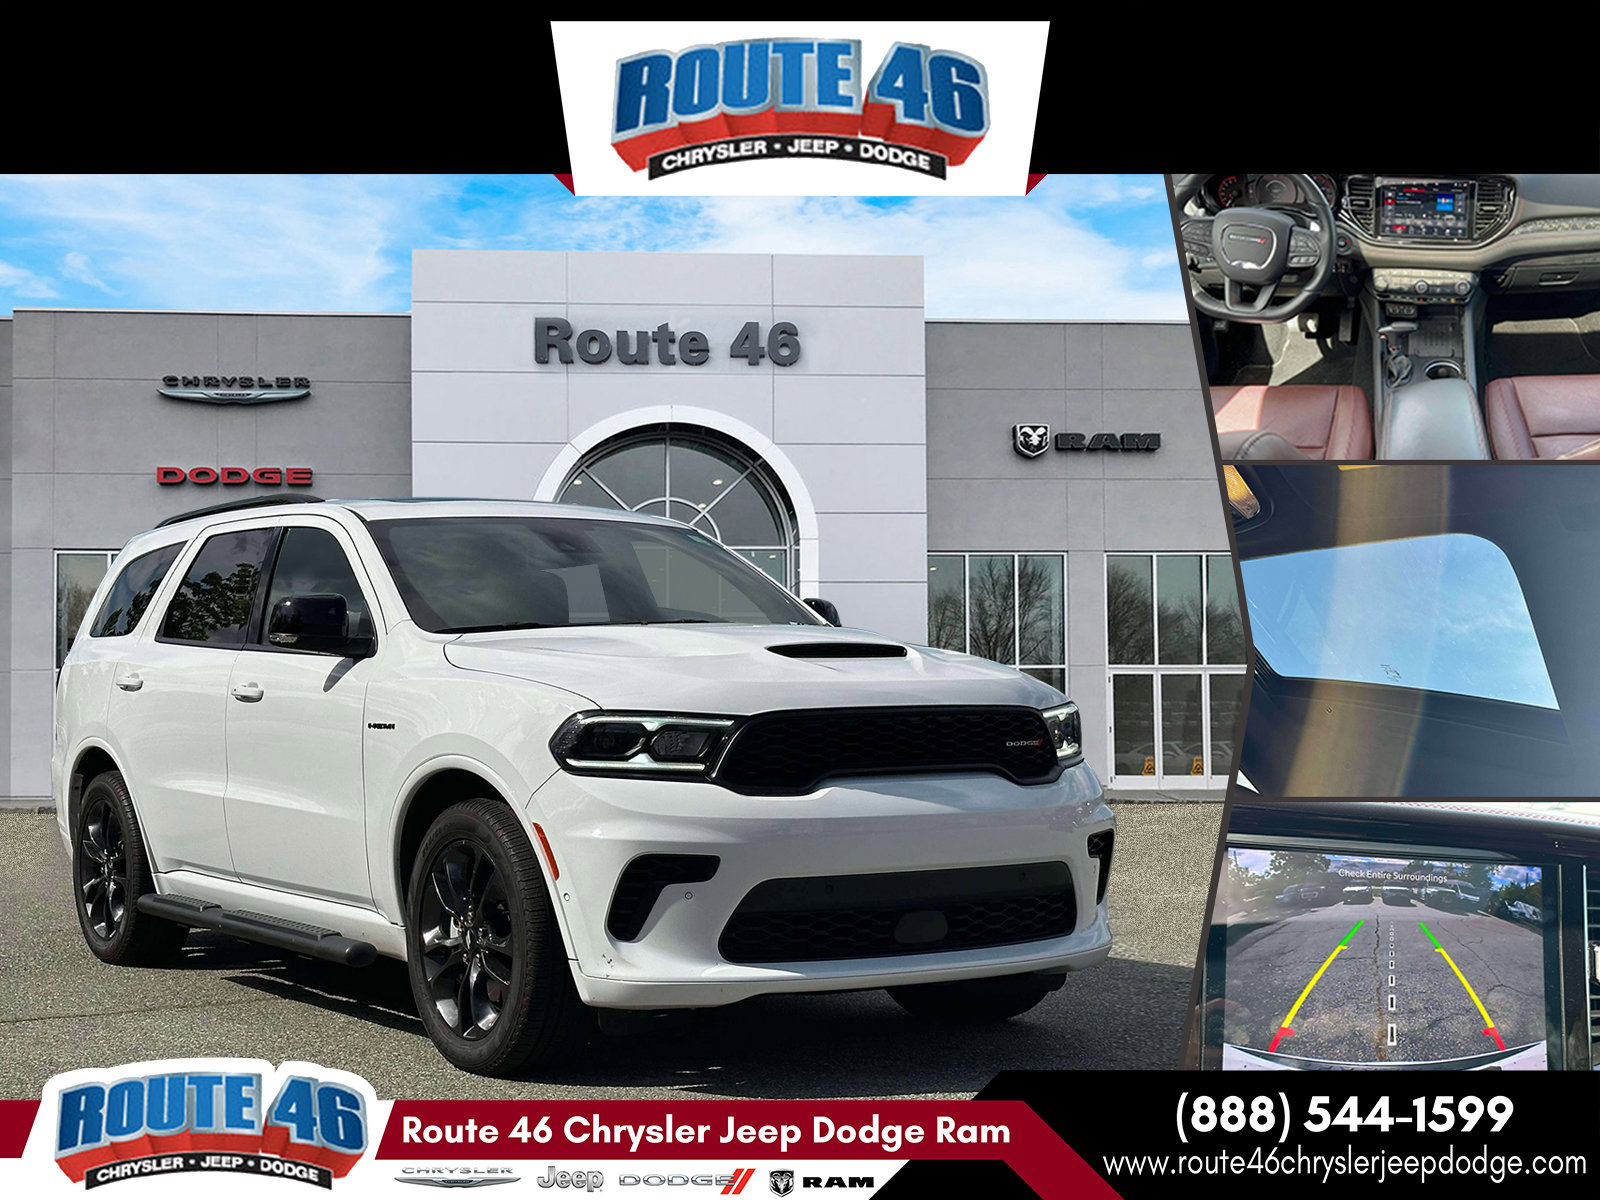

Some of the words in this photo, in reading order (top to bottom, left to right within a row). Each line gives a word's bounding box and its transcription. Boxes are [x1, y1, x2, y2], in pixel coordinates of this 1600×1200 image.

[534, 316, 710, 366] Route
[729, 320, 801, 367] 46
[161, 374, 311, 389] CHRYSLER
[1054, 432, 1161, 452] RAM
[156, 466, 313, 486] DODGE
[1337, 868, 1366, 878] Check
[1366, 870, 1392, 880] Entire
[1392, 872, 1448, 885] Surroundings
